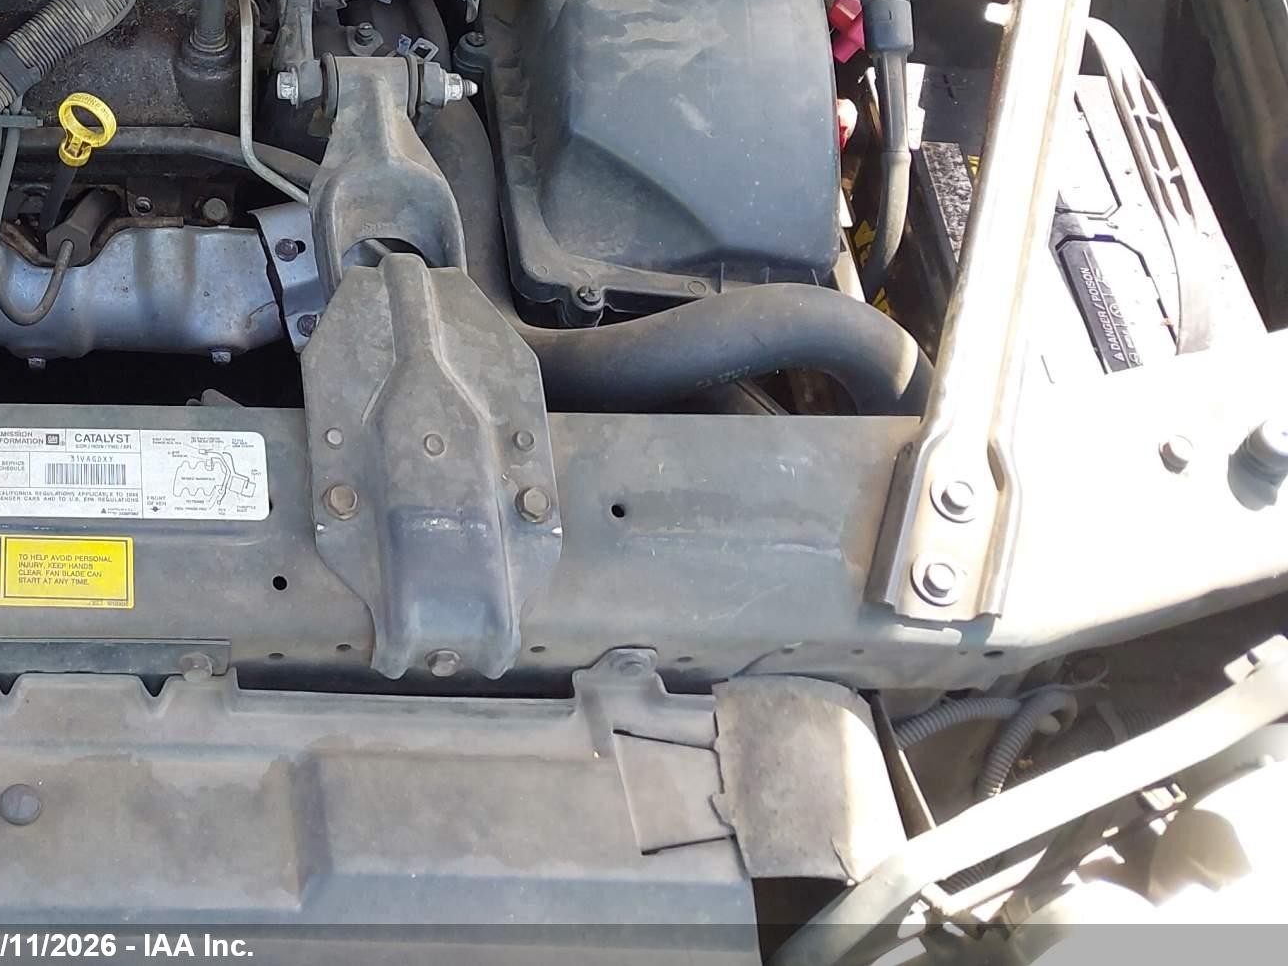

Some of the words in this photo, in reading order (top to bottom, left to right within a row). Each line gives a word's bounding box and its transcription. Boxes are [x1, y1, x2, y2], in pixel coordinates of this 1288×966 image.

[1080, 267, 1103, 302] POISON
[1097, 310, 1121, 352] DANGER
[74, 433, 131, 443] CATALYST
[51, 554, 72, 562] AVOID
[74, 554, 113, 563] PERSONAL
[68, 562, 94, 570] HANDS
[45, 569, 60, 577] FAN
[53, 577, 69, 585] ANY
